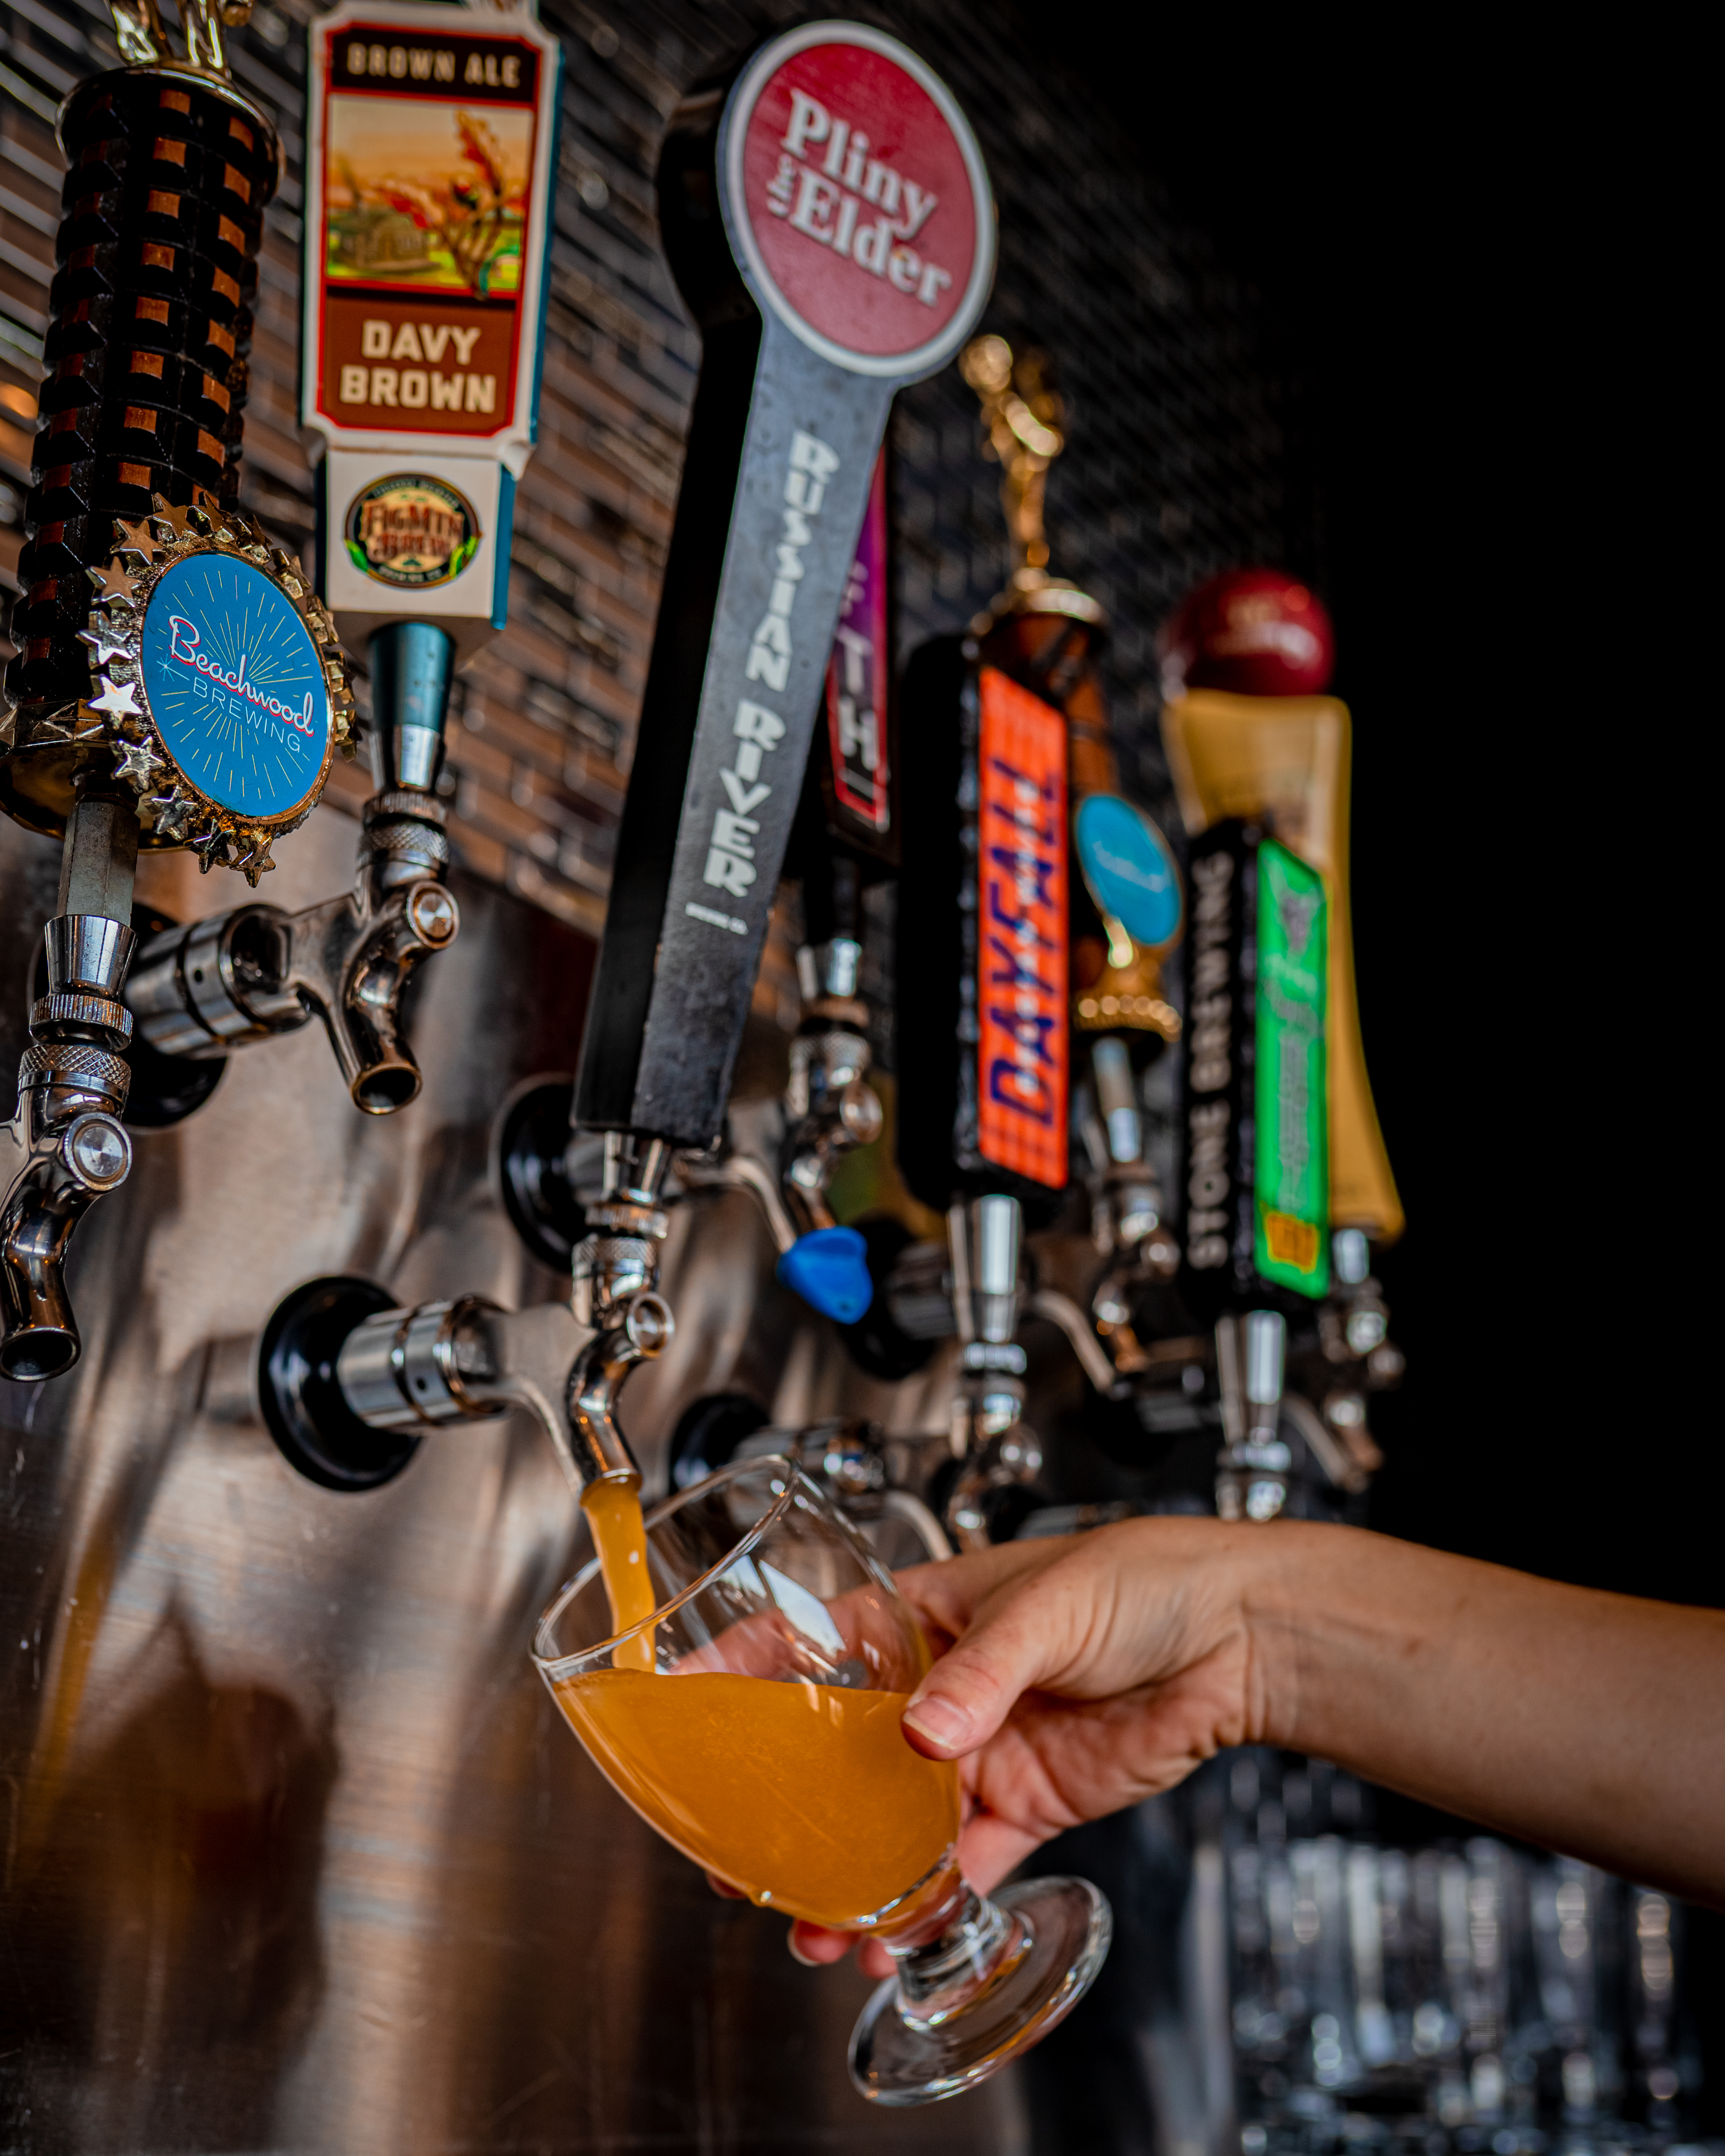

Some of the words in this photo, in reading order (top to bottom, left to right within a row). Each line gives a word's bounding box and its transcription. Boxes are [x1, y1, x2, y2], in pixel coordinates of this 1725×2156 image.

[347, 43, 455, 82] BROWN
[464, 52, 521, 87] ALE
[781, 88, 938, 239] Pliny
[789, 166, 952, 307] Elder
[339, 364, 497, 413] BROWN
[362, 320, 481, 365] DAVY
[745, 427, 841, 692] RUSSIAN
[169, 615, 314, 737] Beachwood
[193, 676, 301, 753] BREWING
[703, 700, 786, 897] RIVER
[990, 756, 1057, 1128] DAYFALL
[1186, 1097, 1231, 1269] STONE
